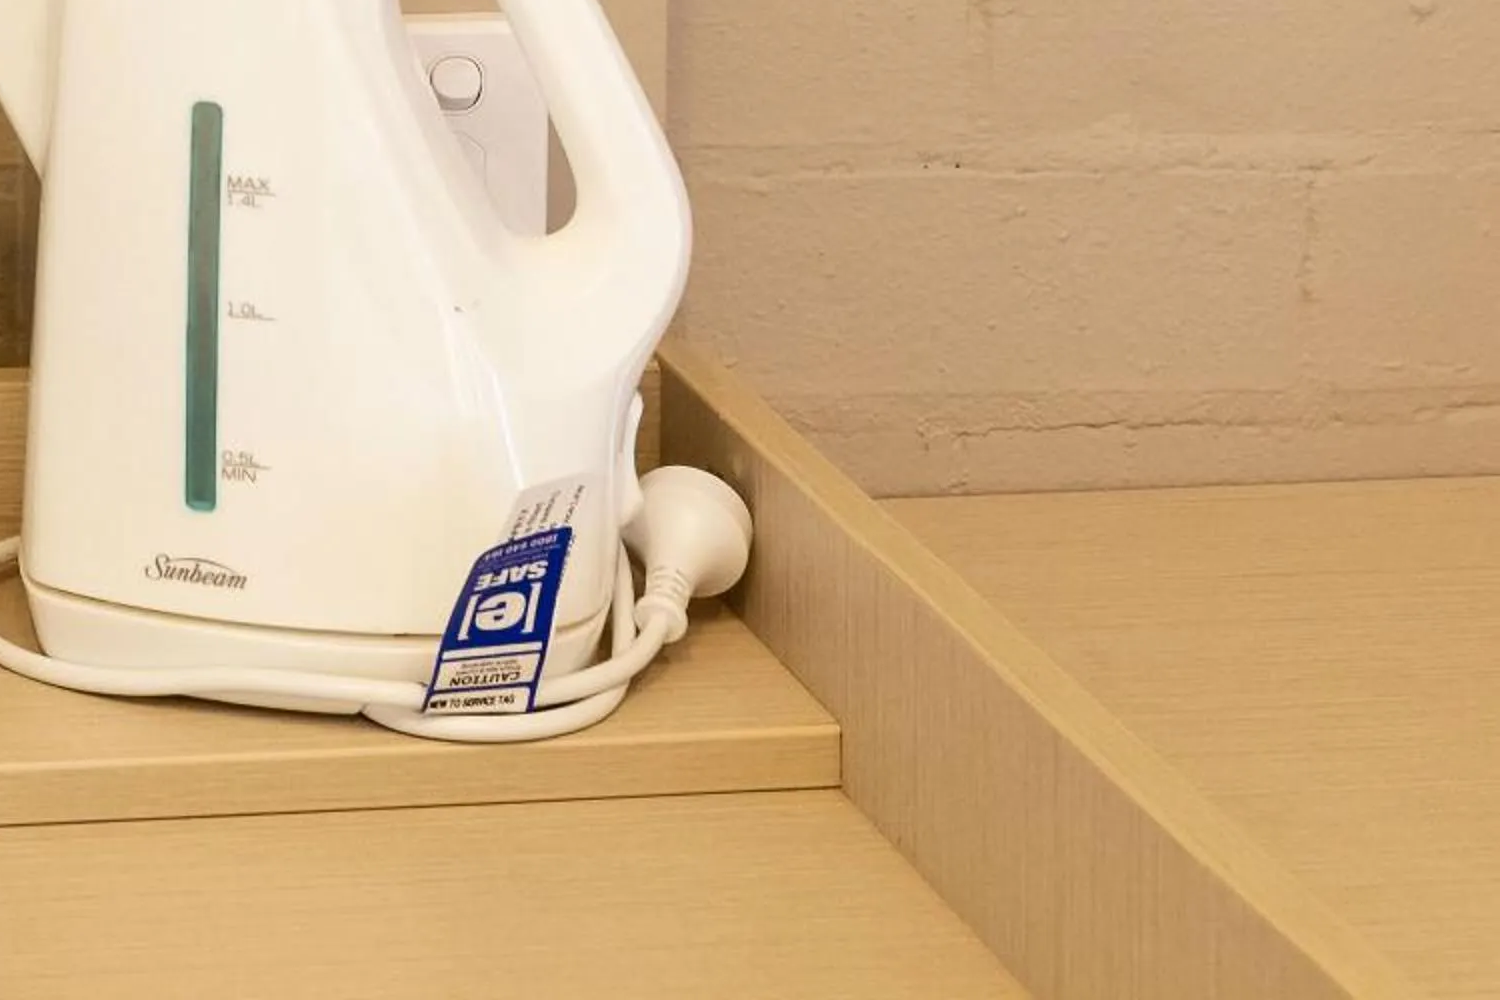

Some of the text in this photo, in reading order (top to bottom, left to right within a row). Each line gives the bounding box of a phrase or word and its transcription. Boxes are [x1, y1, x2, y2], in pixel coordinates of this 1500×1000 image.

[227, 175, 271, 191] MAX
[221, 468, 257, 484] MIN
[144, 554, 248, 589] Sunbeam
[473, 560, 549, 591] SAFE
[449, 671, 521, 687] CAUTION
[450, 698, 461, 708] TO
